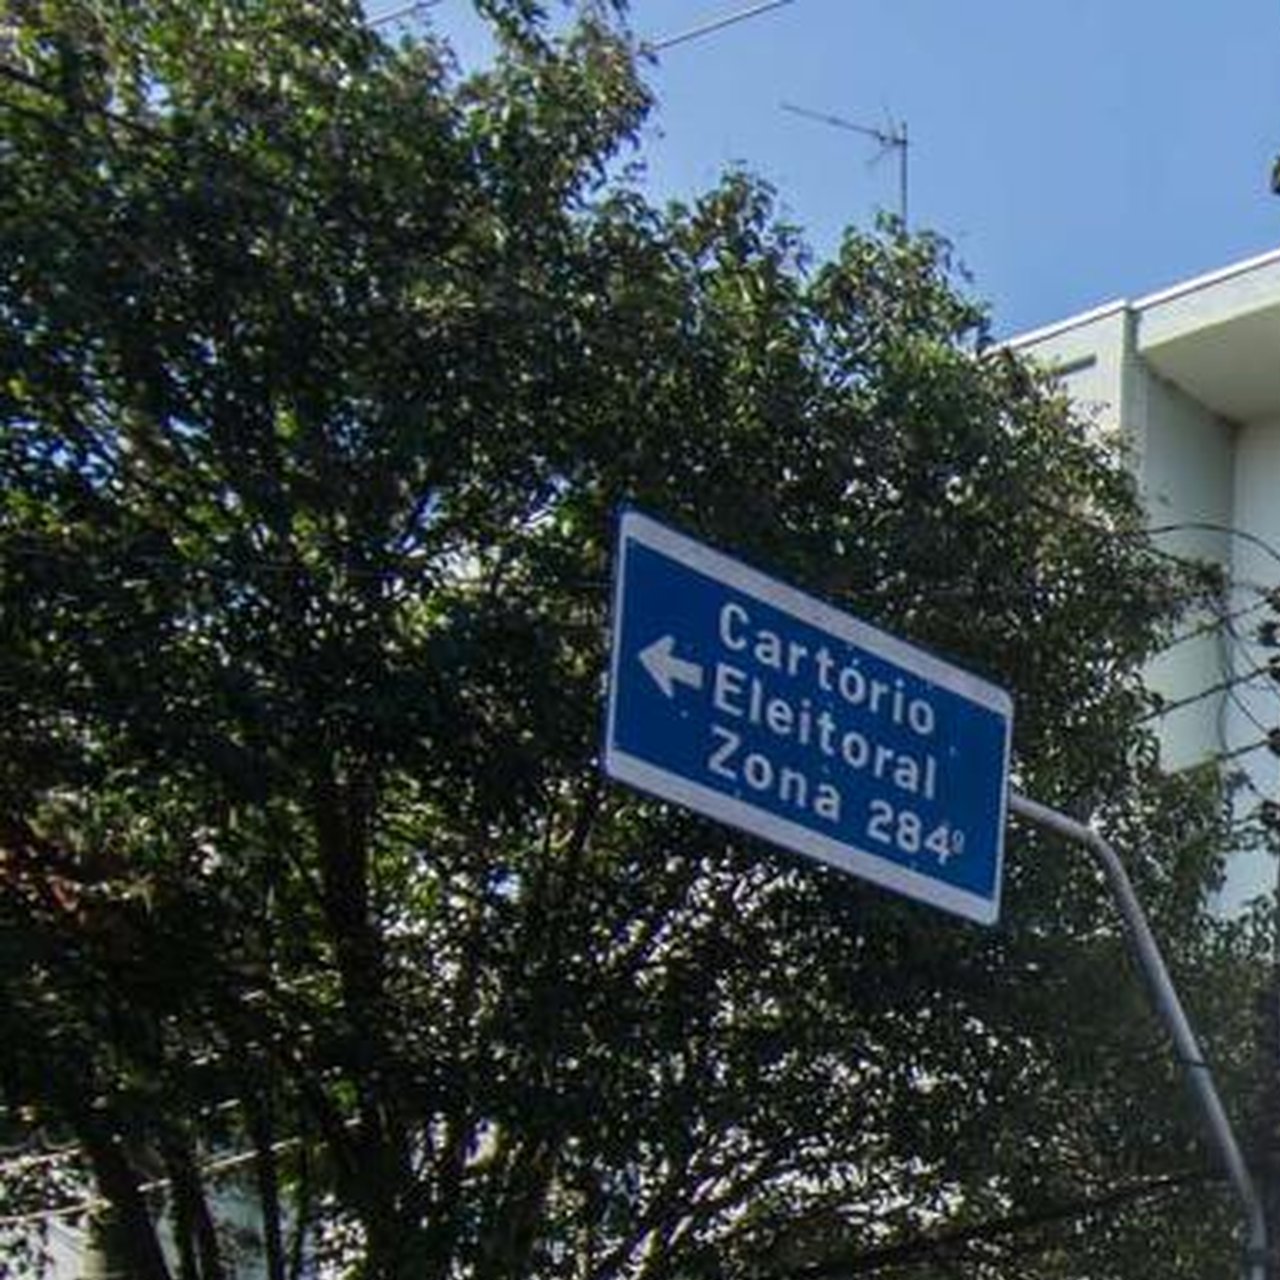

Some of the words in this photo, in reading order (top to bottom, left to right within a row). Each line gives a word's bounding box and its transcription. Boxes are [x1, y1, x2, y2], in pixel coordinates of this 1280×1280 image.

[713, 663, 936, 799] Eleitoral
[719, 604, 935, 734] Cartório
[708, 727, 840, 821] Zona
